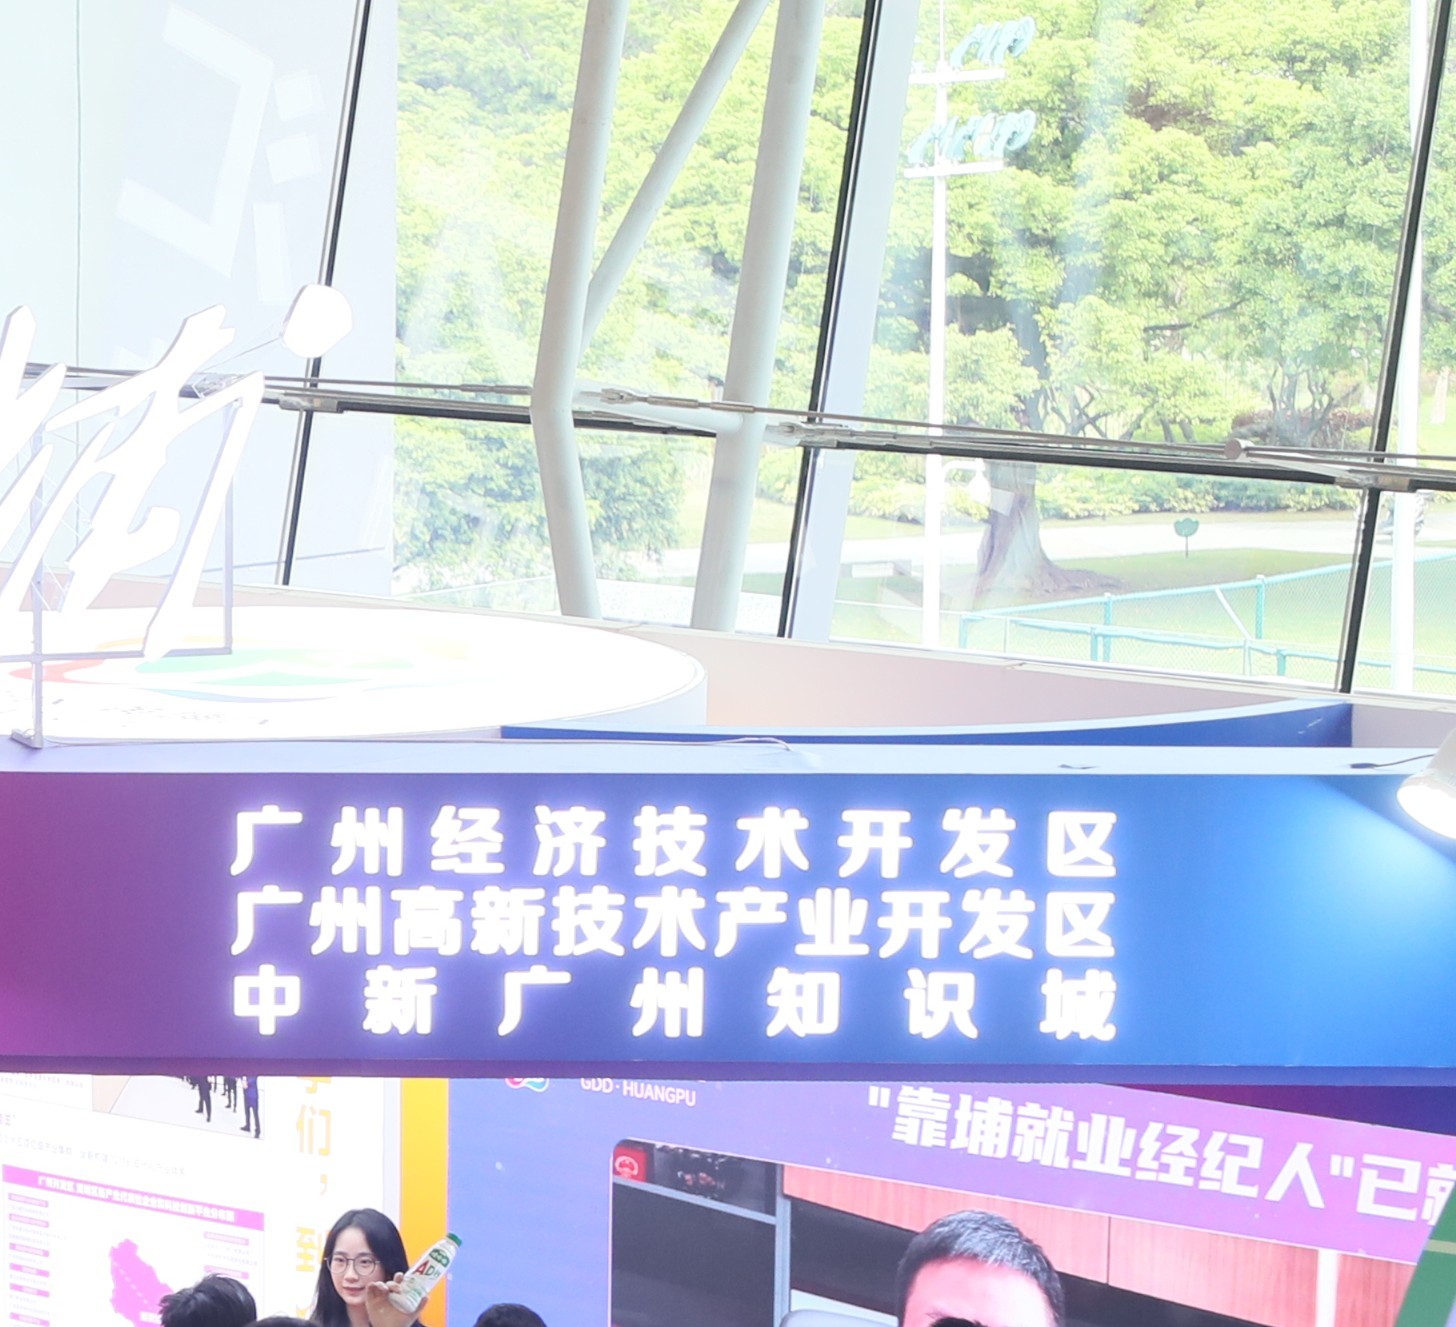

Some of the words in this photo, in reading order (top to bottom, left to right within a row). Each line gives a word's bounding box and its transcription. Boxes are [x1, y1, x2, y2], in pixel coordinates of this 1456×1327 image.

[228, 804, 1119, 880] 广州经济技术开发区
[228, 884, 1119, 960] 广州高新技术产业开发区
[228, 964, 1119, 1042] 中新广州知识城
[622, 1080, 697, 1107] HUANGPU
